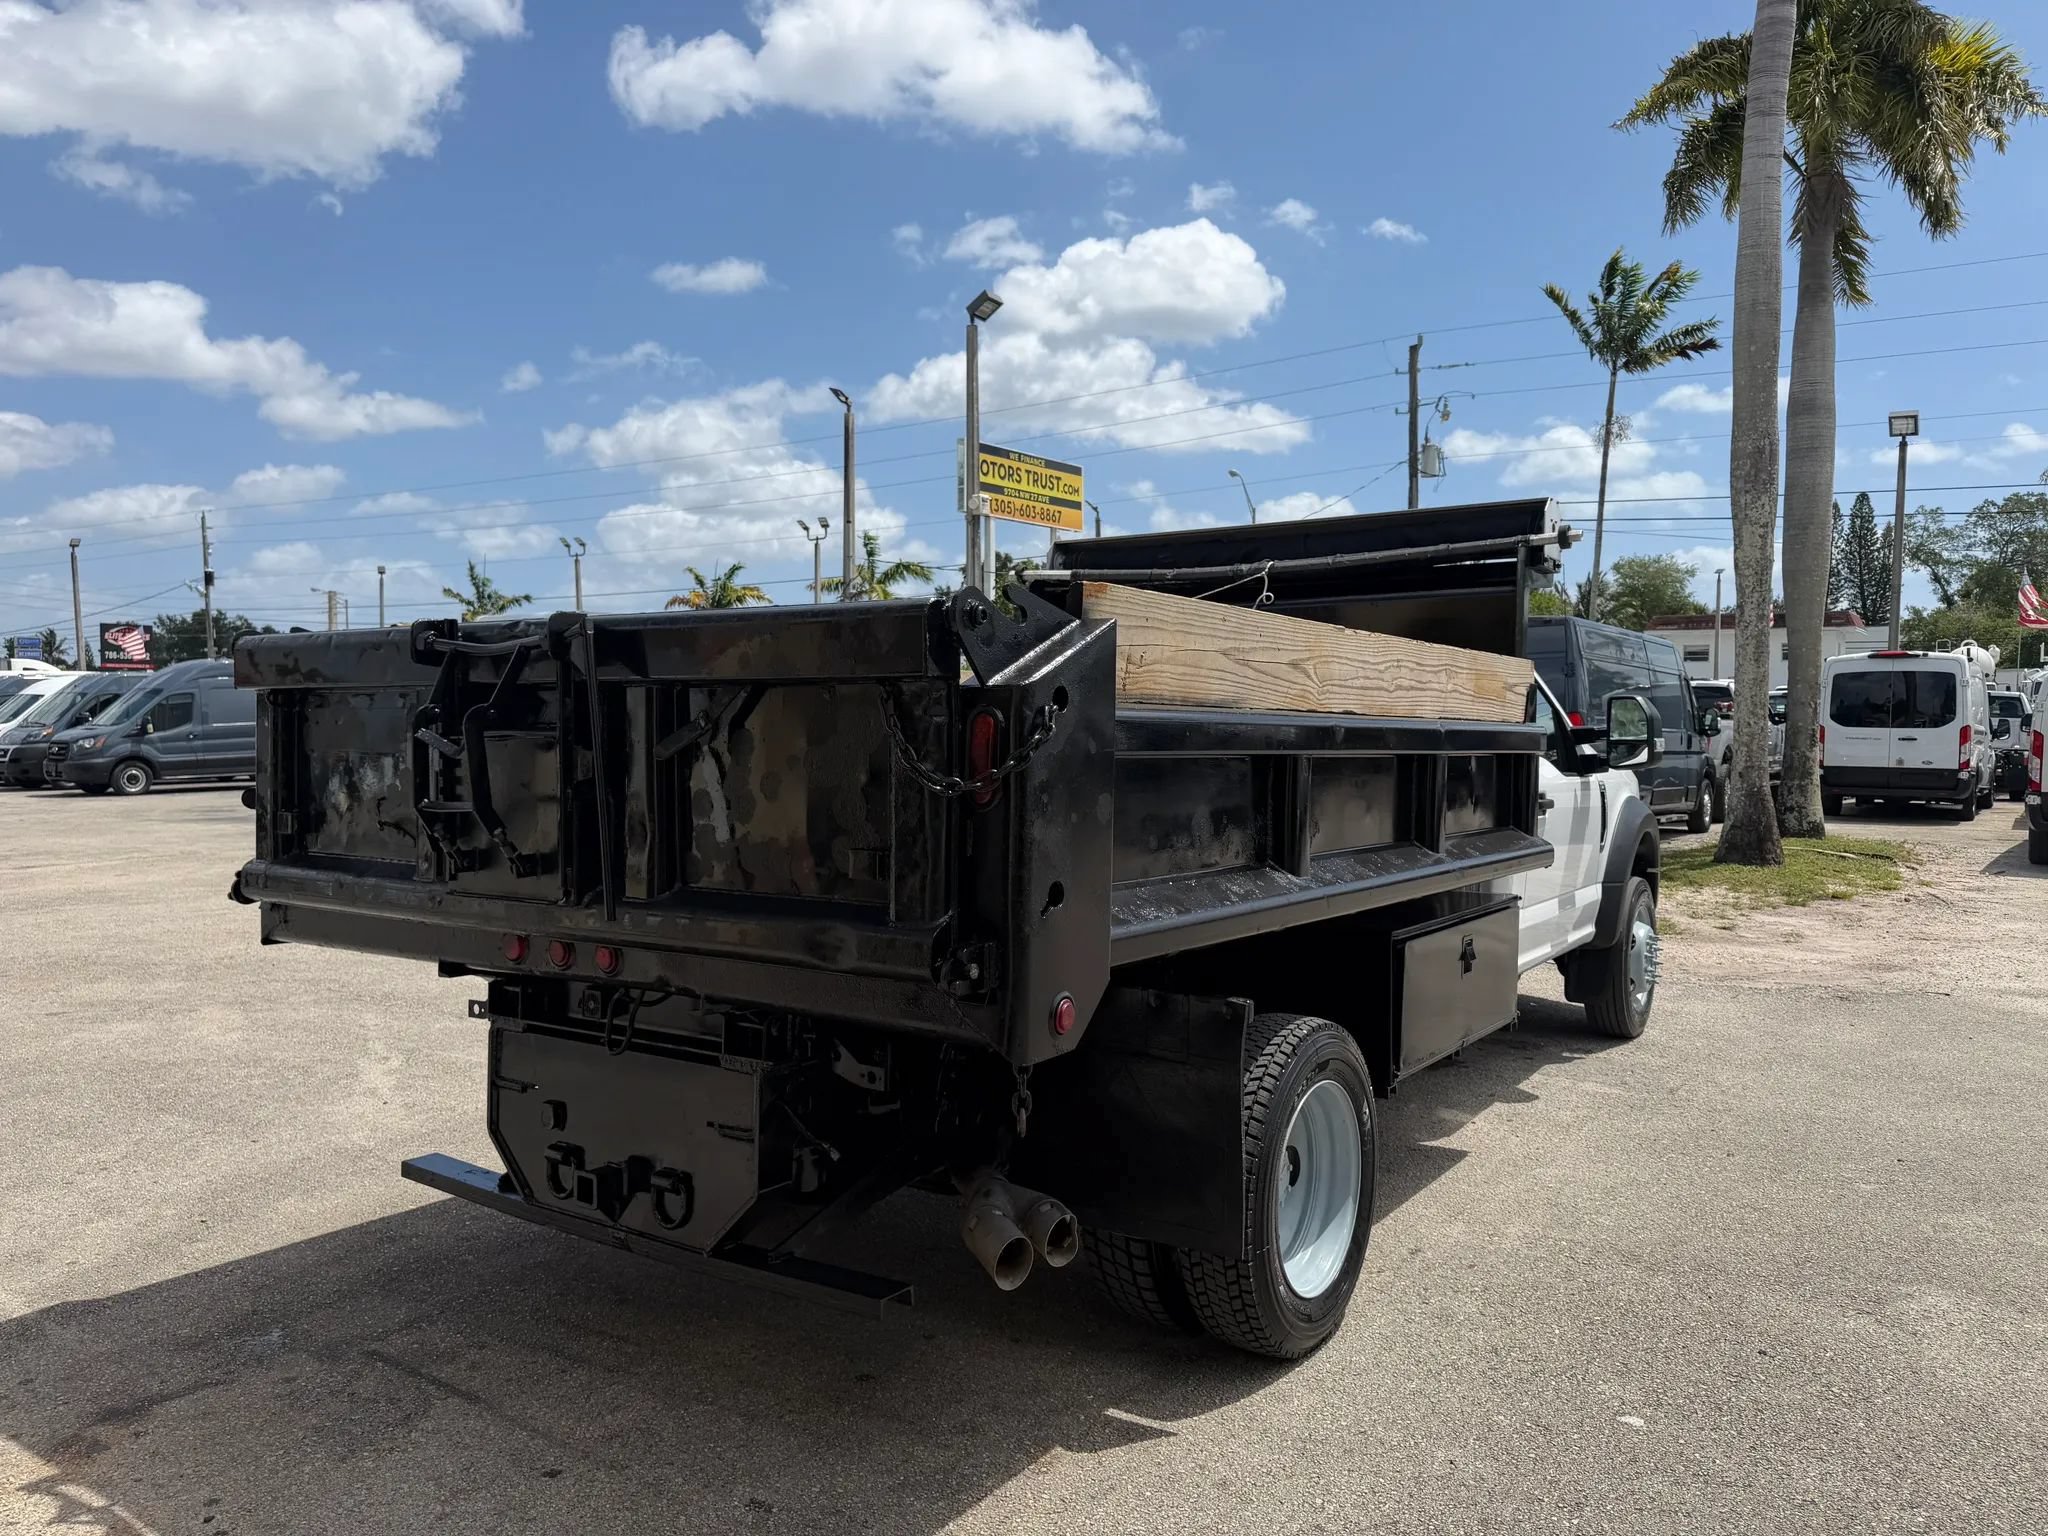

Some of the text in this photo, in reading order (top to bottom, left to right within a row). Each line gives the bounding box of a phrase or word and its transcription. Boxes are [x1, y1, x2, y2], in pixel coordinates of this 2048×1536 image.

[1009, 452, 1046, 467] WE FINANCE
[980, 459, 1022, 484] OTORS
[1019, 491, 1030, 500] NW
[1038, 495, 1050, 504] AVE
